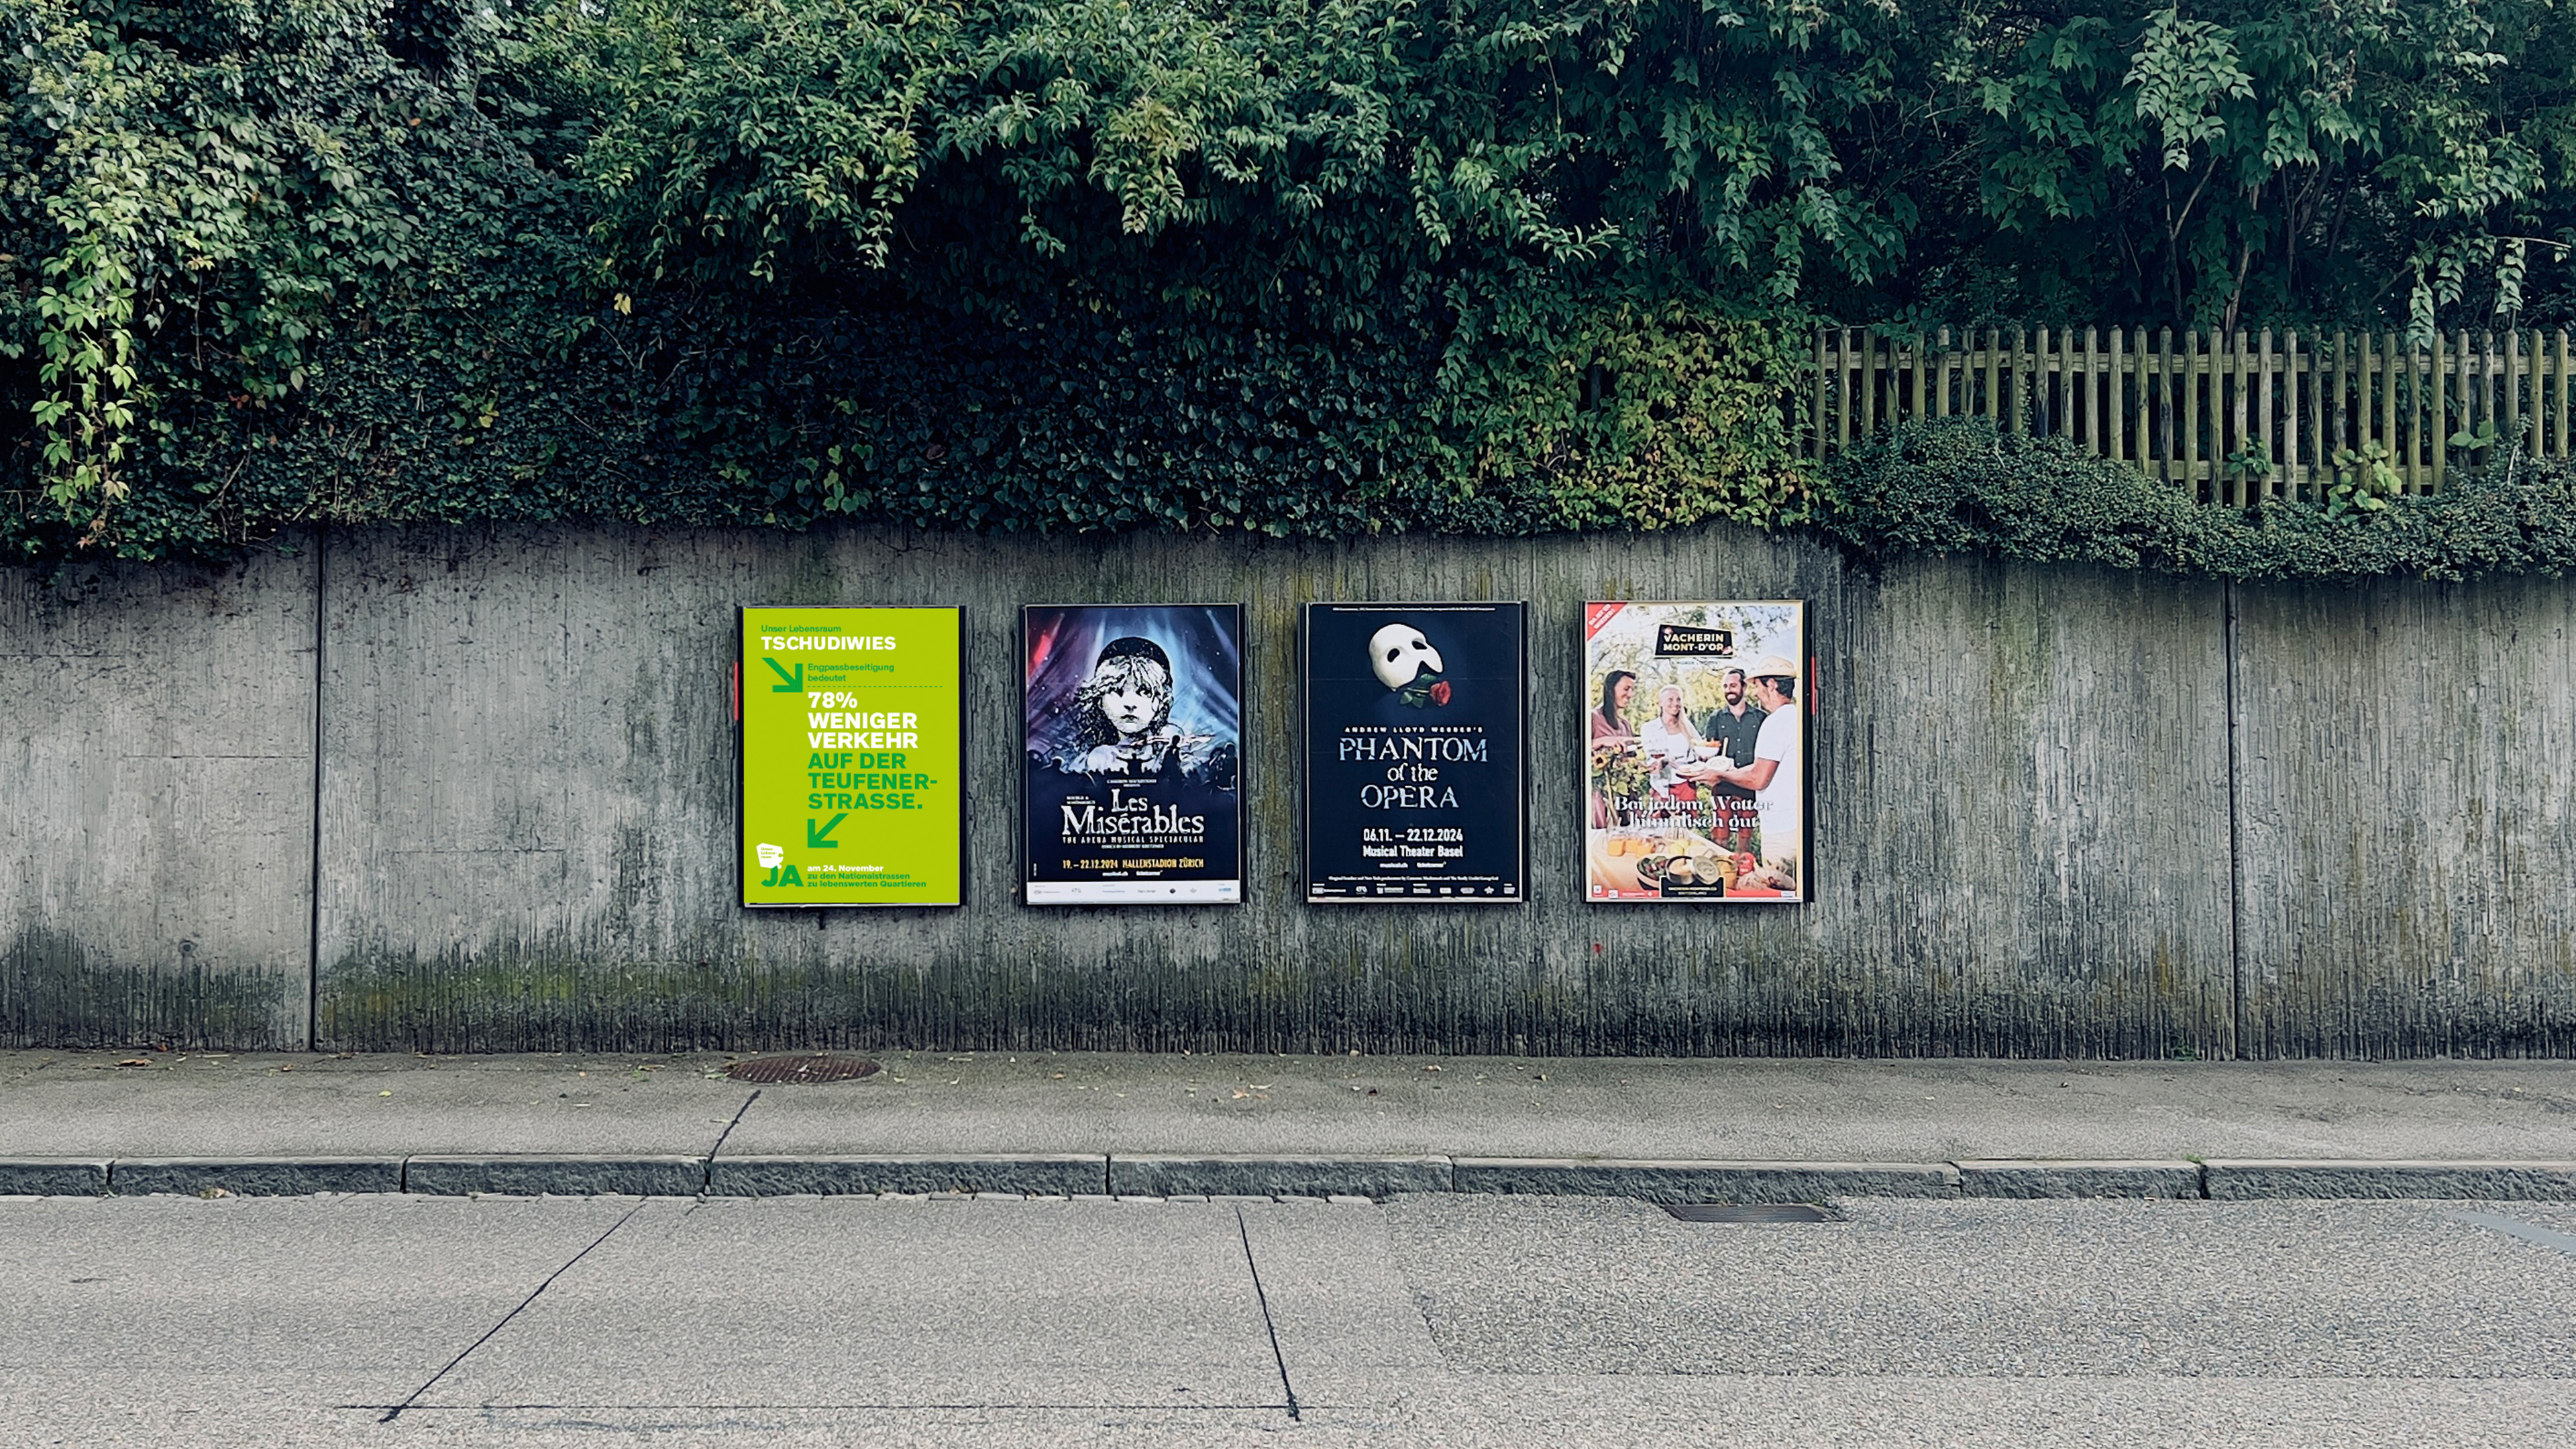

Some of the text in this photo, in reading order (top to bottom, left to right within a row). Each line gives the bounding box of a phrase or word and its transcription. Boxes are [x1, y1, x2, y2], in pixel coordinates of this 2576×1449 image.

[761, 625, 842, 633] Unser Lebensraum
[761, 636, 896, 651] TSCHUDIWIES
[1664, 633, 1724, 642] VACHERIN
[808, 663, 895, 673] Engpassbeseitigung
[808, 692, 858, 708] 78%
[808, 712, 918, 729] WENIGER
[808, 732, 918, 749] VERKEHR
[1340, 737, 1488, 762] PHANTOM
[808, 753, 906, 769] AUF DER
[1387, 763, 1438, 782] of the
[808, 772, 938, 790] TEUFENER-
[808, 793, 923, 810] STRASSE.
[1111, 788, 1148, 812] Les
[1360, 784, 1459, 809] OPERA
[1061, 804, 1205, 835] Misérables
[1063, 836, 1077, 844] THE
[1081, 836, 1106, 844] ARENA
[1363, 828, 1393, 842] 06.11.
[1407, 828, 1463, 842] 22.12.2024
[1362, 845, 1464, 857] Musical Theater Basel
[1080, 859, 1118, 869] 22.12.2024
[1122, 859, 1177, 869] HALLENSTADION
[1179, 857, 1204, 868] ZÜRICH
[761, 865, 804, 888] JA
